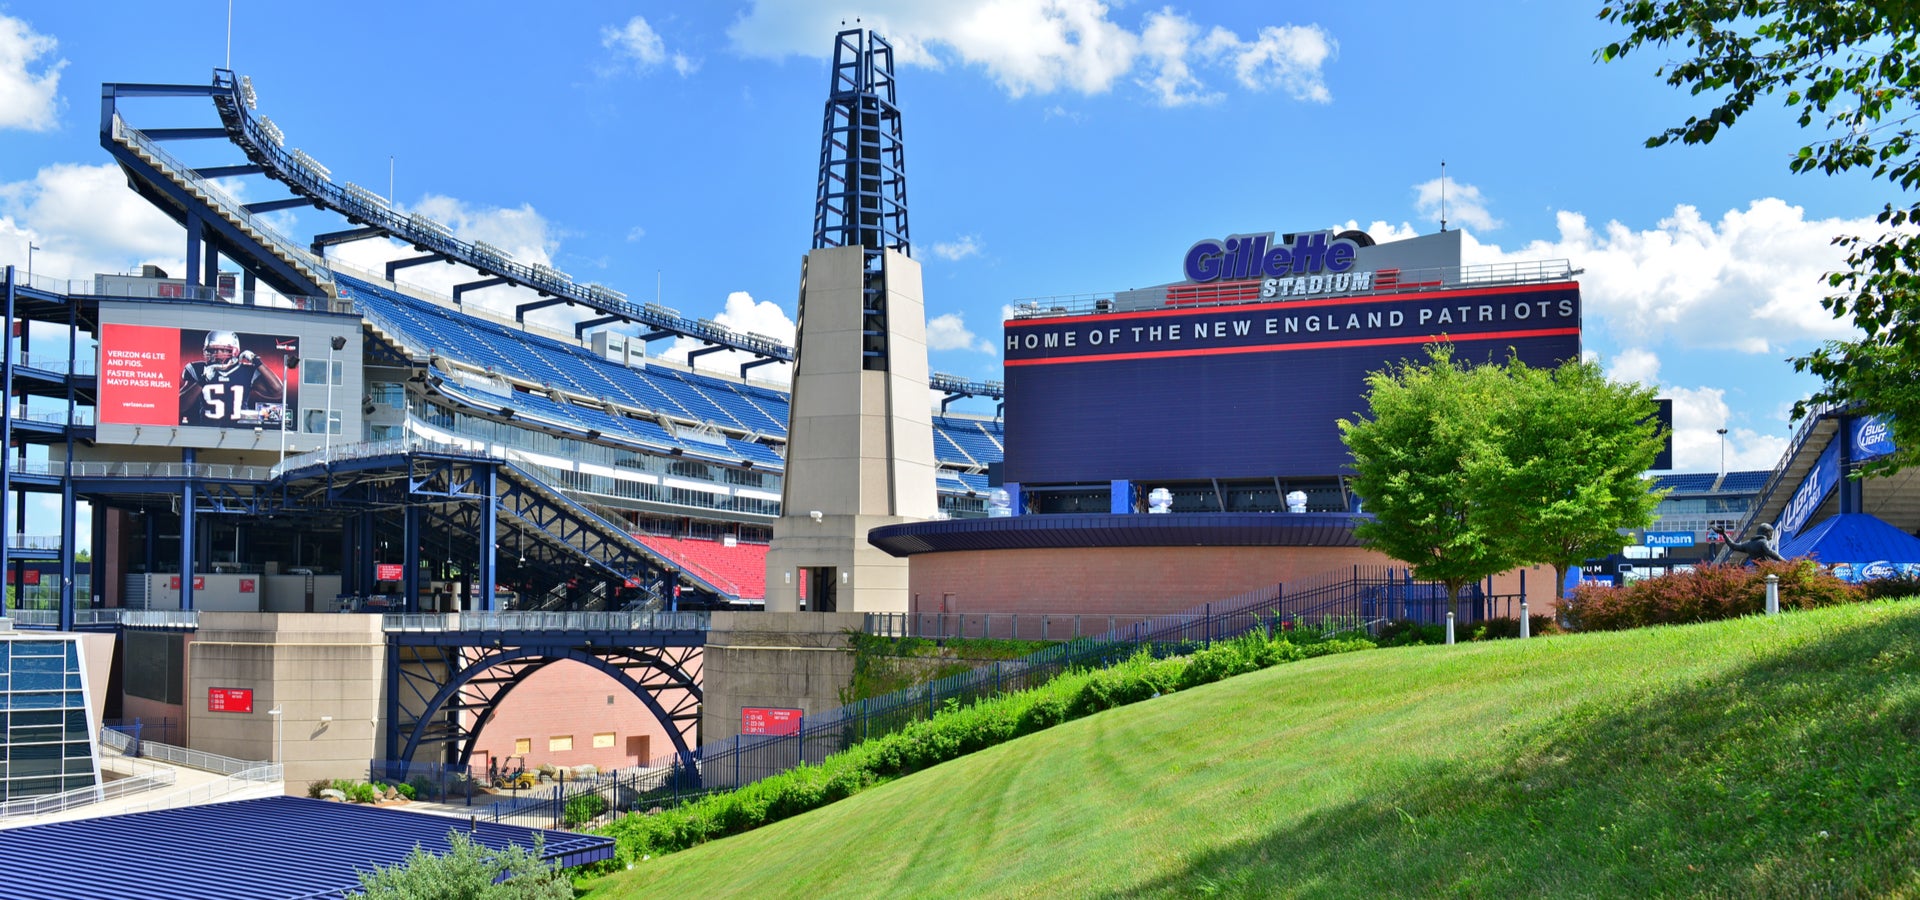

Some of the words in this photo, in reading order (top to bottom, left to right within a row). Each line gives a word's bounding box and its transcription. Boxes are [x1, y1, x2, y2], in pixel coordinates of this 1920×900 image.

[1186, 233, 1355, 282] Gillette
[1263, 272, 1372, 298] STADIUM
[1007, 331, 1077, 350] HOME
[1089, 328, 1121, 345] OF
[1132, 325, 1181, 342] THE
[1194, 320, 1251, 338] NEW
[1265, 310, 1404, 334] ENGLAND
[1419, 299, 1573, 325] PATRIOTS
[107, 350, 140, 359] VERIZON
[107, 370, 135, 378] FASTER
[137, 371, 157, 379] THAN
[107, 378, 129, 386] MAYO
[130, 379, 149, 387] PASS
[150, 380, 173, 388] RUSH.
[202, 384, 244, 420] 51
[1865, 422, 1886, 437] BUD
[1861, 431, 1887, 447] LIGHT
[1786, 465, 1821, 527] LIGHT
[1646, 534, 1692, 544] Putnam
